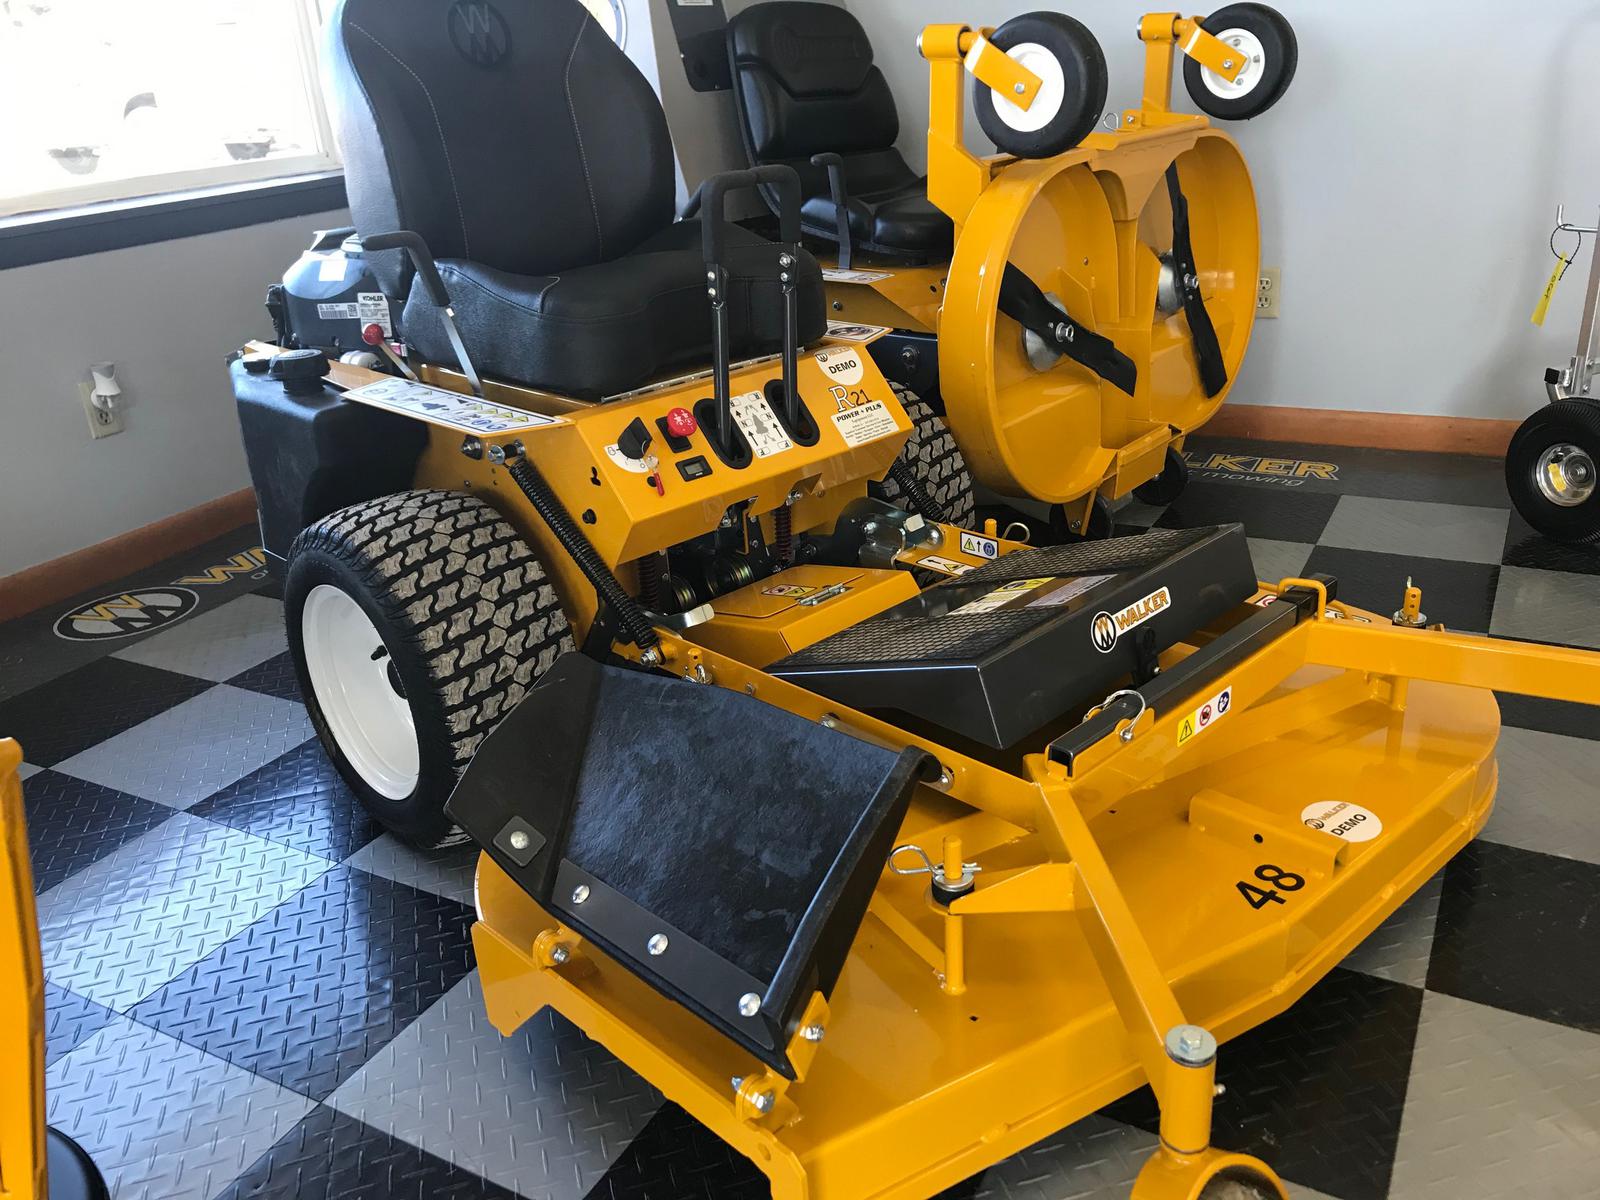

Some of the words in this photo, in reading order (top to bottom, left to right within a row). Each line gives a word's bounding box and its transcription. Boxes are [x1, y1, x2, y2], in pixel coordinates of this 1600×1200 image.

[828, 359, 857, 374] DEMO
[828, 384, 872, 413] R21
[836, 410, 860, 423] POWER
[1202, 471, 1305, 487] mowing
[1115, 589, 1169, 631] WALKER
[1330, 813, 1367, 836] DEMO
[1235, 863, 1306, 910] 48
